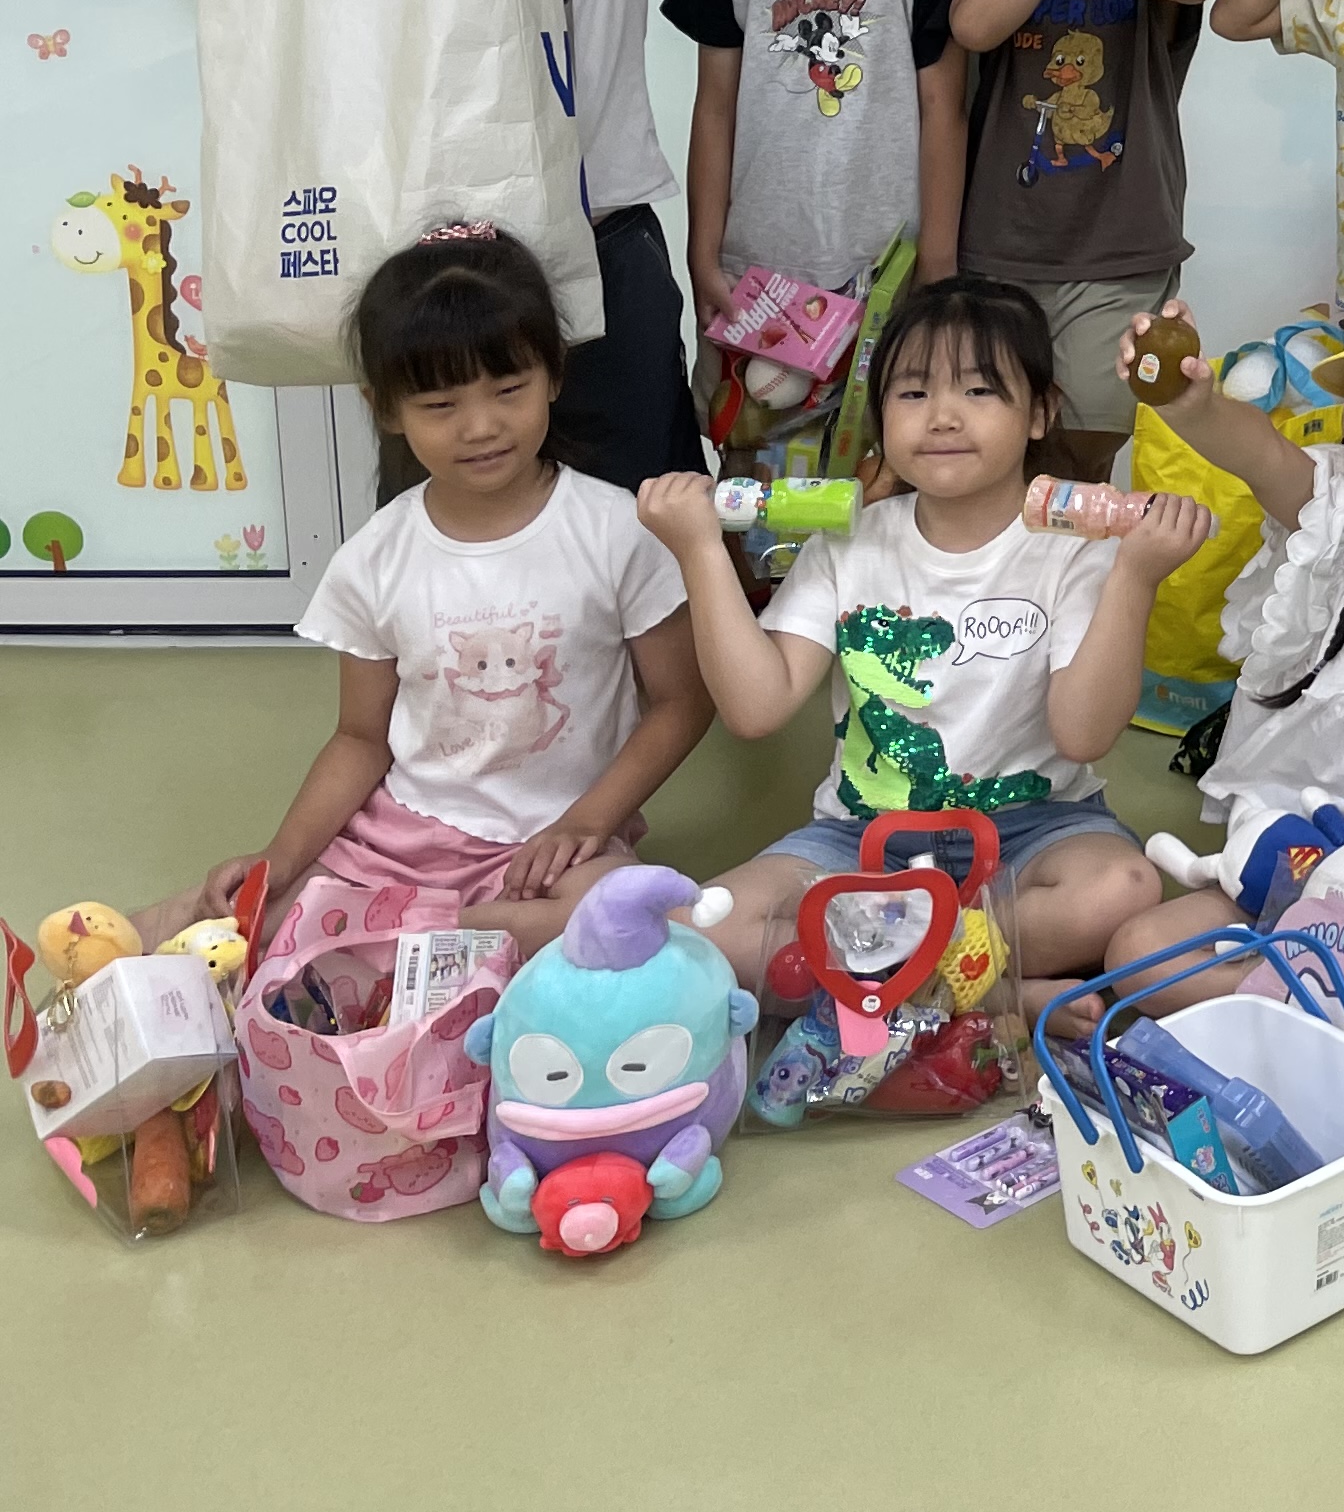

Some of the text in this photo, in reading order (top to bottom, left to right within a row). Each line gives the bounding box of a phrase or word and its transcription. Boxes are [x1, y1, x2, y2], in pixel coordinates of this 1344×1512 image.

[283, 187, 338, 218] 스파오
[281, 221, 338, 245] COOL
[280, 249, 339, 279] 페스타
[434, 604, 518, 629] Beautiful
